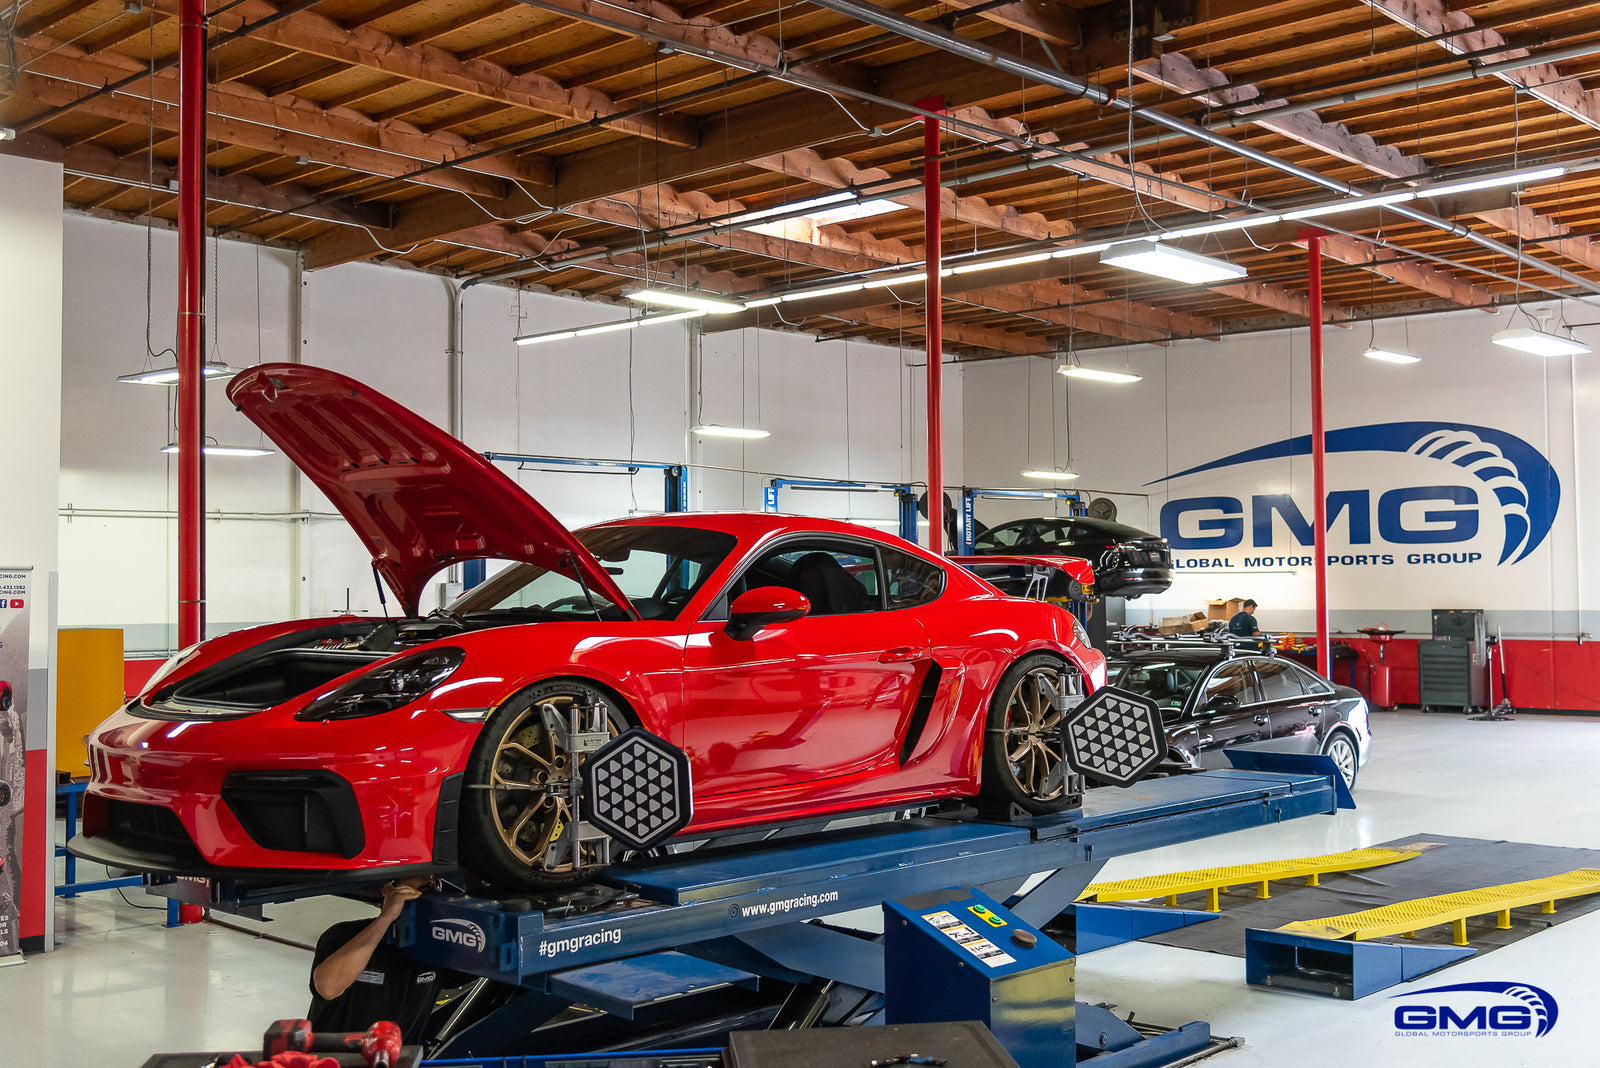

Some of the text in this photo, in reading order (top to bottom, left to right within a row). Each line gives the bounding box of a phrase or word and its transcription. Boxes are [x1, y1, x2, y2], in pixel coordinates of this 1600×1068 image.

[767, 487, 775, 505] LIFT
[1160, 485, 1479, 550] GMG
[1172, 551, 1482, 568] LOBAL MOTORPORTS GROUP
[742, 891, 838, 917] www.gmgracing.com
[432, 926, 477, 947] GMG
[539, 928, 621, 957] #gmgracing
